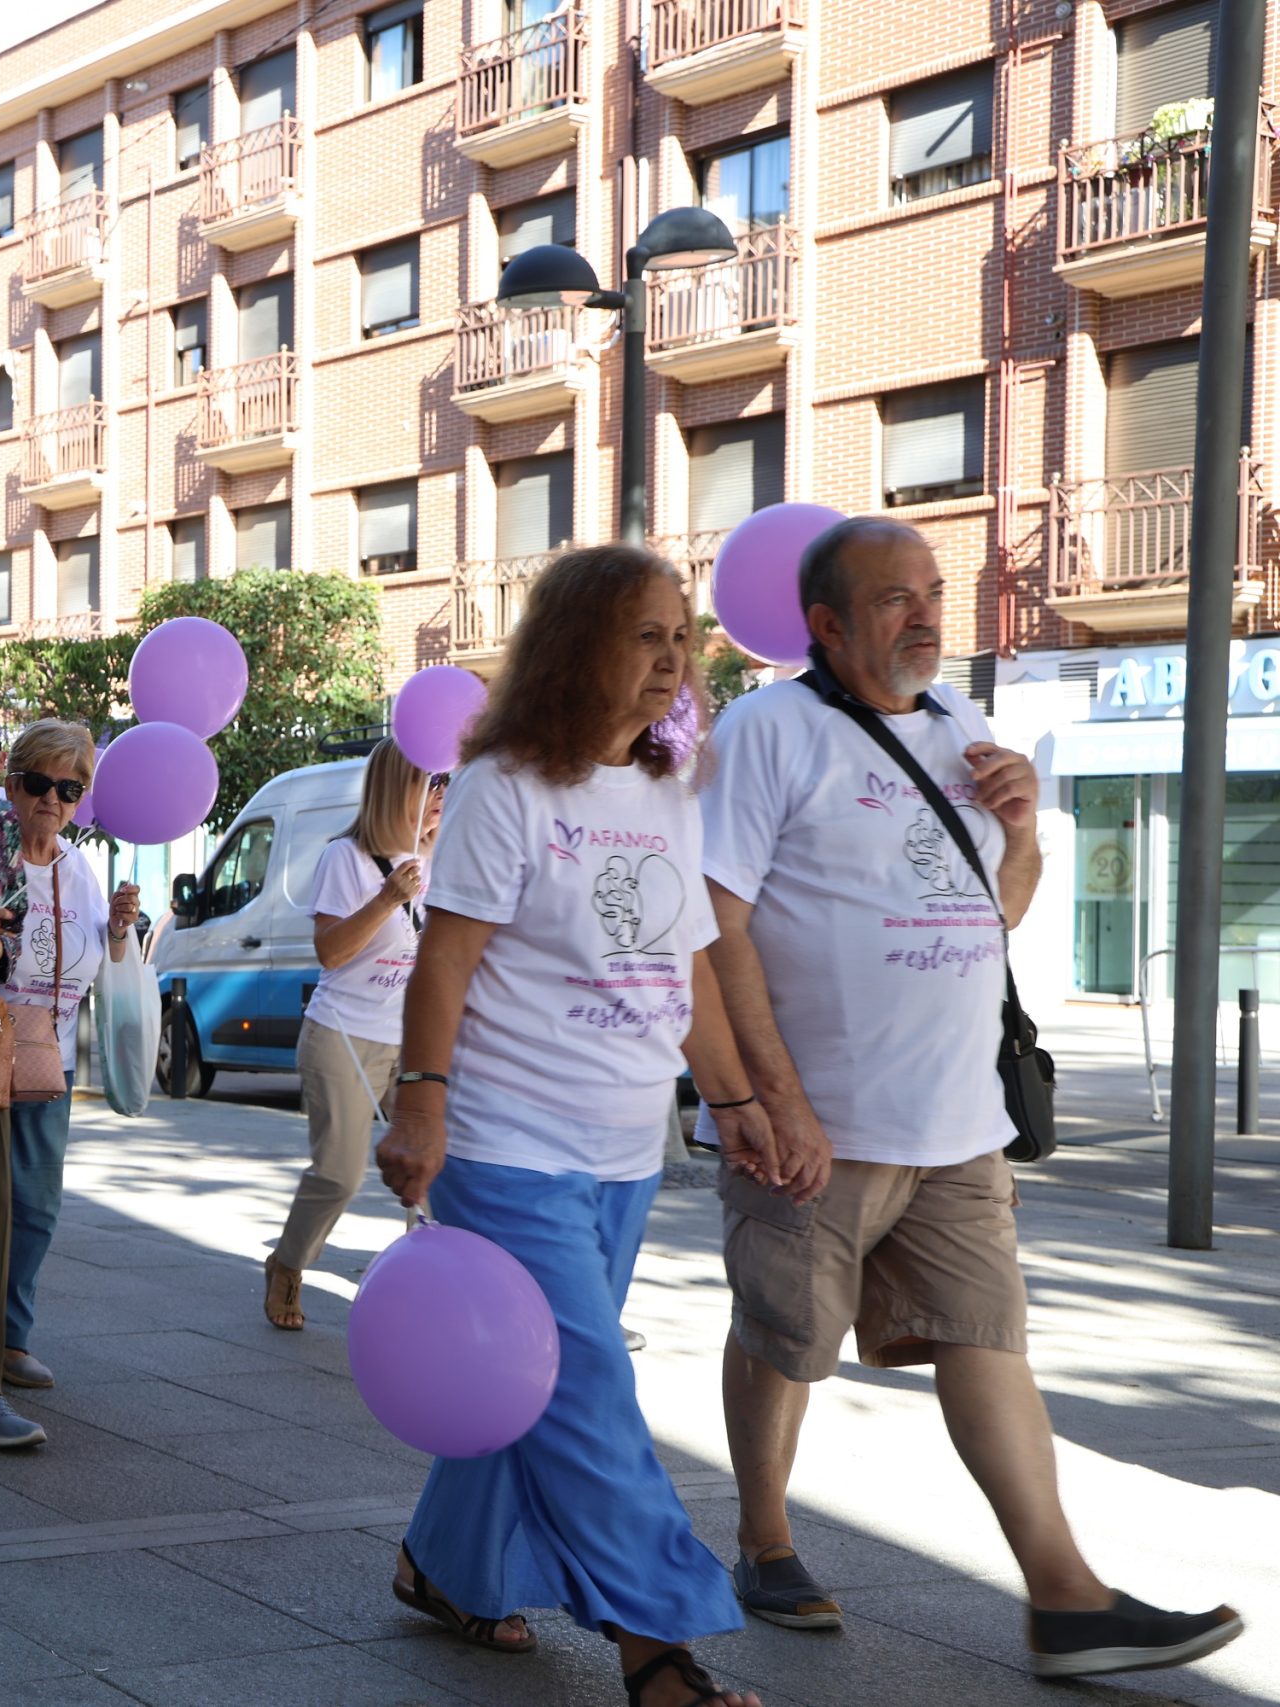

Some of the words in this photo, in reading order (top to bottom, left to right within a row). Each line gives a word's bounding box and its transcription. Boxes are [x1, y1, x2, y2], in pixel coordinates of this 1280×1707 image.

[589, 830, 668, 852] AFAMSO
[1096, 856, 1124, 878] 20
[30, 903, 77, 919] AFASO
